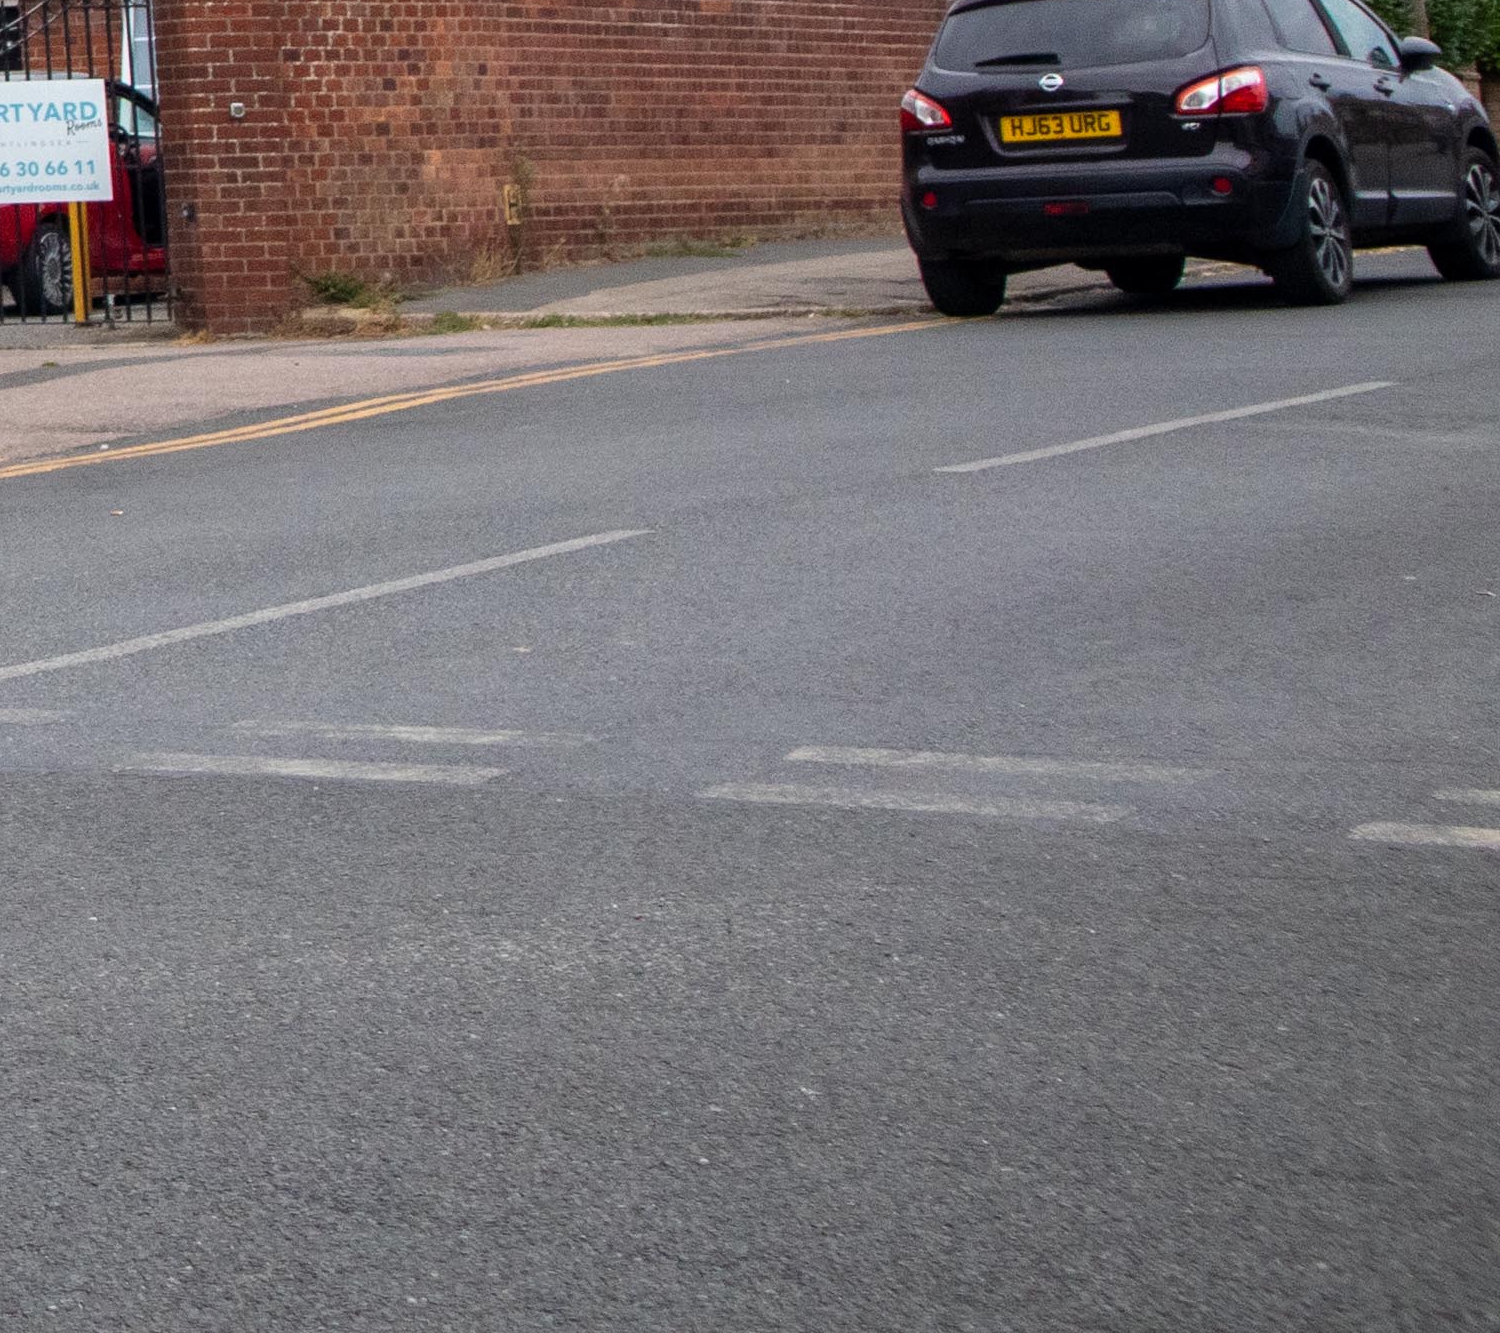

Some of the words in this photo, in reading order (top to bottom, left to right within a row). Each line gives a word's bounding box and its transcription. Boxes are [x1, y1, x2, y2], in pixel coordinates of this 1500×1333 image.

[65, 118, 103, 136] Rooms
[1010, 116, 1064, 137] HJ63
[1069, 113, 1111, 134] URG
[16, 161, 40, 177] 30
[45, 160, 69, 176] 66
[74, 159, 96, 175] 11
